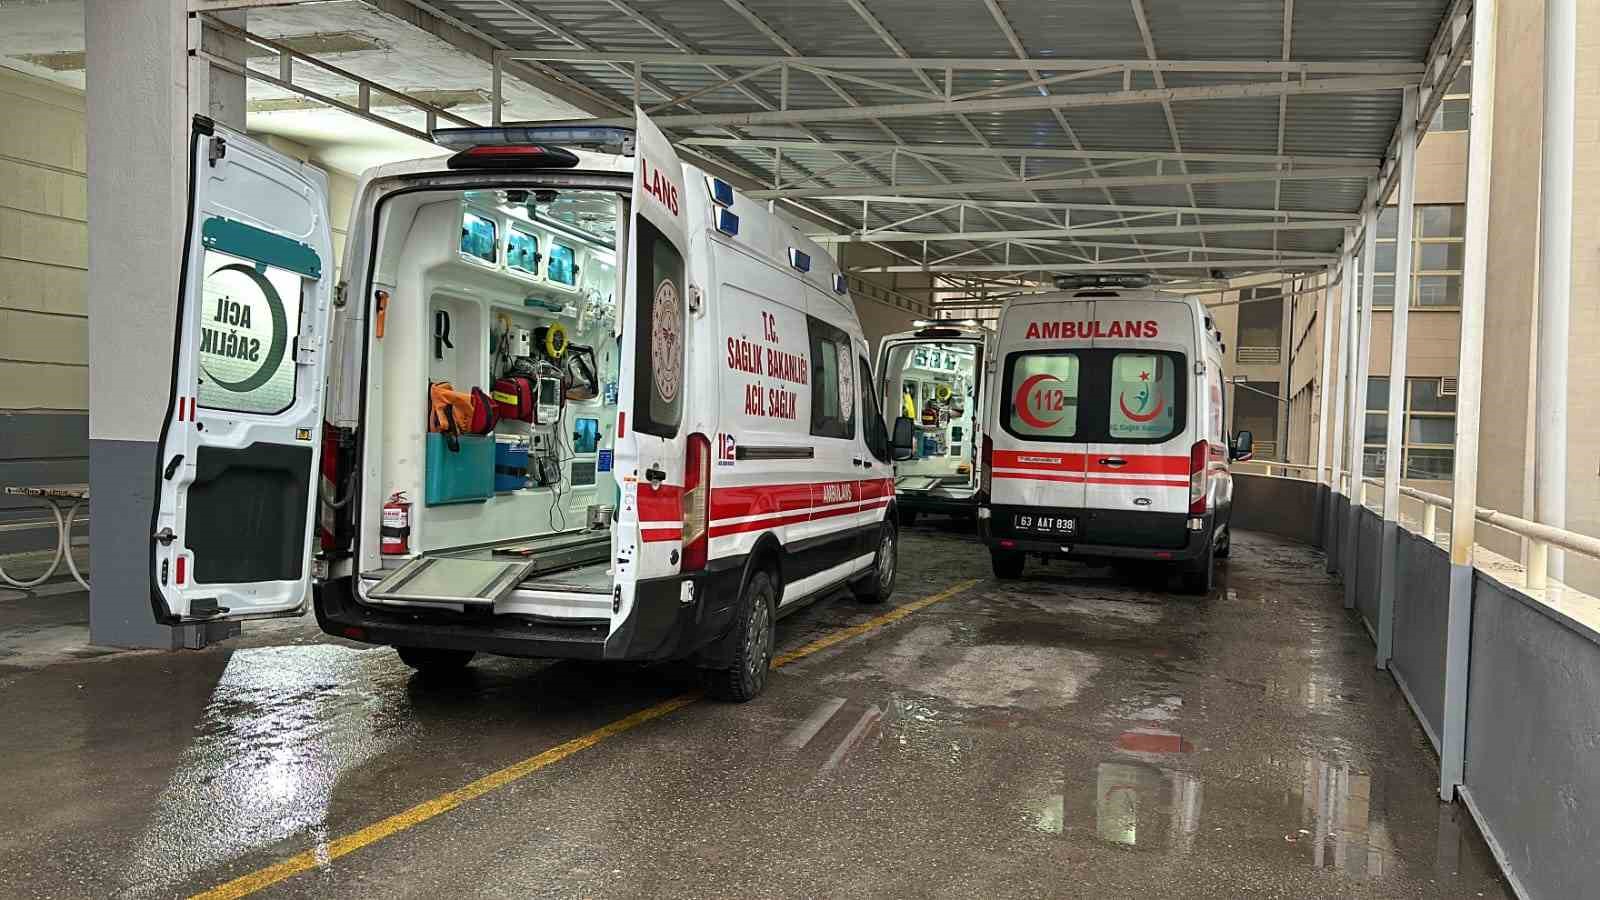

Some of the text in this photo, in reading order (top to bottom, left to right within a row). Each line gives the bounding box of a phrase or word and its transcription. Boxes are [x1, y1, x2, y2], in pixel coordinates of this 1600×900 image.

[642, 158, 679, 217] LANS
[762, 310, 779, 344] T.C.
[1025, 320, 1158, 339] AMBULANS
[727, 335, 808, 385] SAĞLIK BAKANLIĞI
[745, 380, 797, 420] ACİL SAĞLIK
[1034, 389, 1064, 411] 112
[718, 432, 735, 460] 112
[1056, 519, 1073, 529] 838
